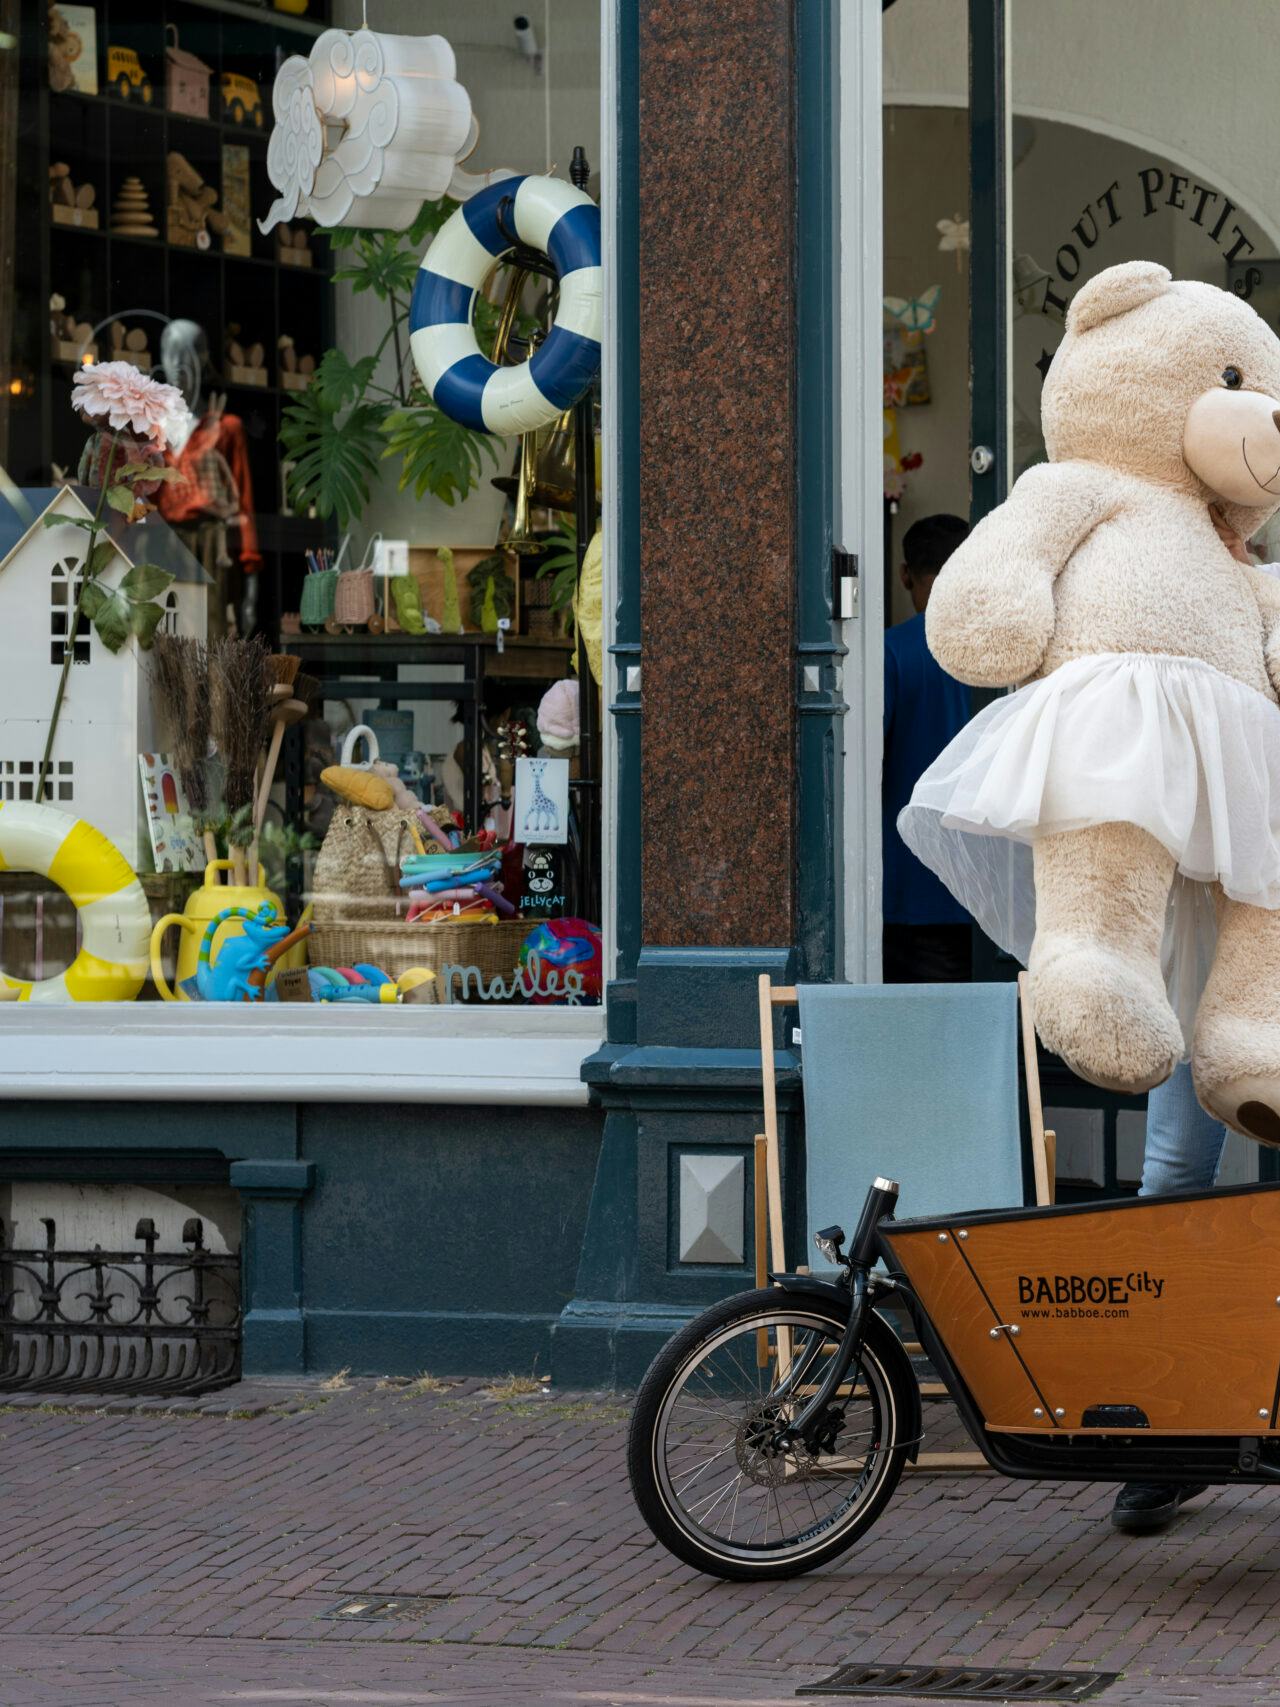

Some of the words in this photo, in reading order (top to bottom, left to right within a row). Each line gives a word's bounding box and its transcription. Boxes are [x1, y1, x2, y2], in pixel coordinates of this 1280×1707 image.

[1042, 180, 1122, 317] TOUT
[1137, 167, 1262, 300] PETITS
[1018, 1276, 1129, 1304] BABBOE
[1020, 1307, 1130, 1319] www.babboe.com
